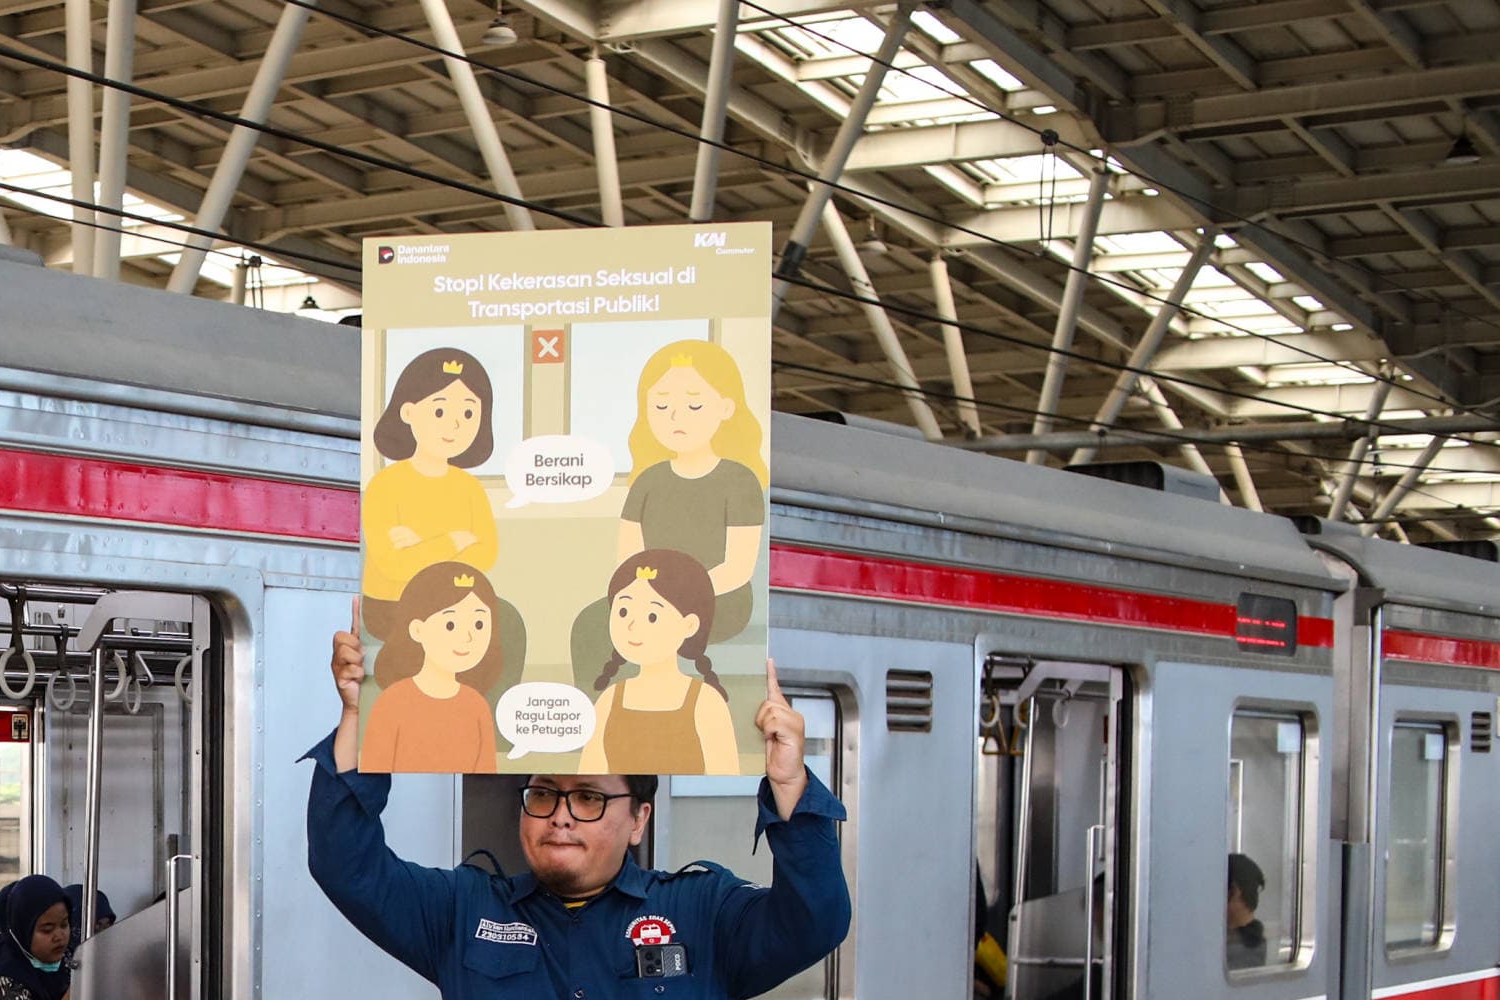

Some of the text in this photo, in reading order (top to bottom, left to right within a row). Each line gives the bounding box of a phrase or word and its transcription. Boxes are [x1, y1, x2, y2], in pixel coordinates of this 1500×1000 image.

[694, 232, 726, 247] KAI
[397, 244, 450, 254] Danantara
[715, 247, 756, 255] Commuter
[397, 254, 446, 264] Indonesia
[434, 267, 696, 295] Stop! Kekerasan Seksual di
[468, 295, 660, 319] Transportasi Publik!
[534, 453, 584, 467] Berani
[525, 472, 592, 488] Bersikap
[526, 697, 570, 709] Jangan
[515, 710, 581, 723] Ragu Lapor
[516, 724, 582, 737] ke Petugas!
[674, 953, 682, 971] POCO
